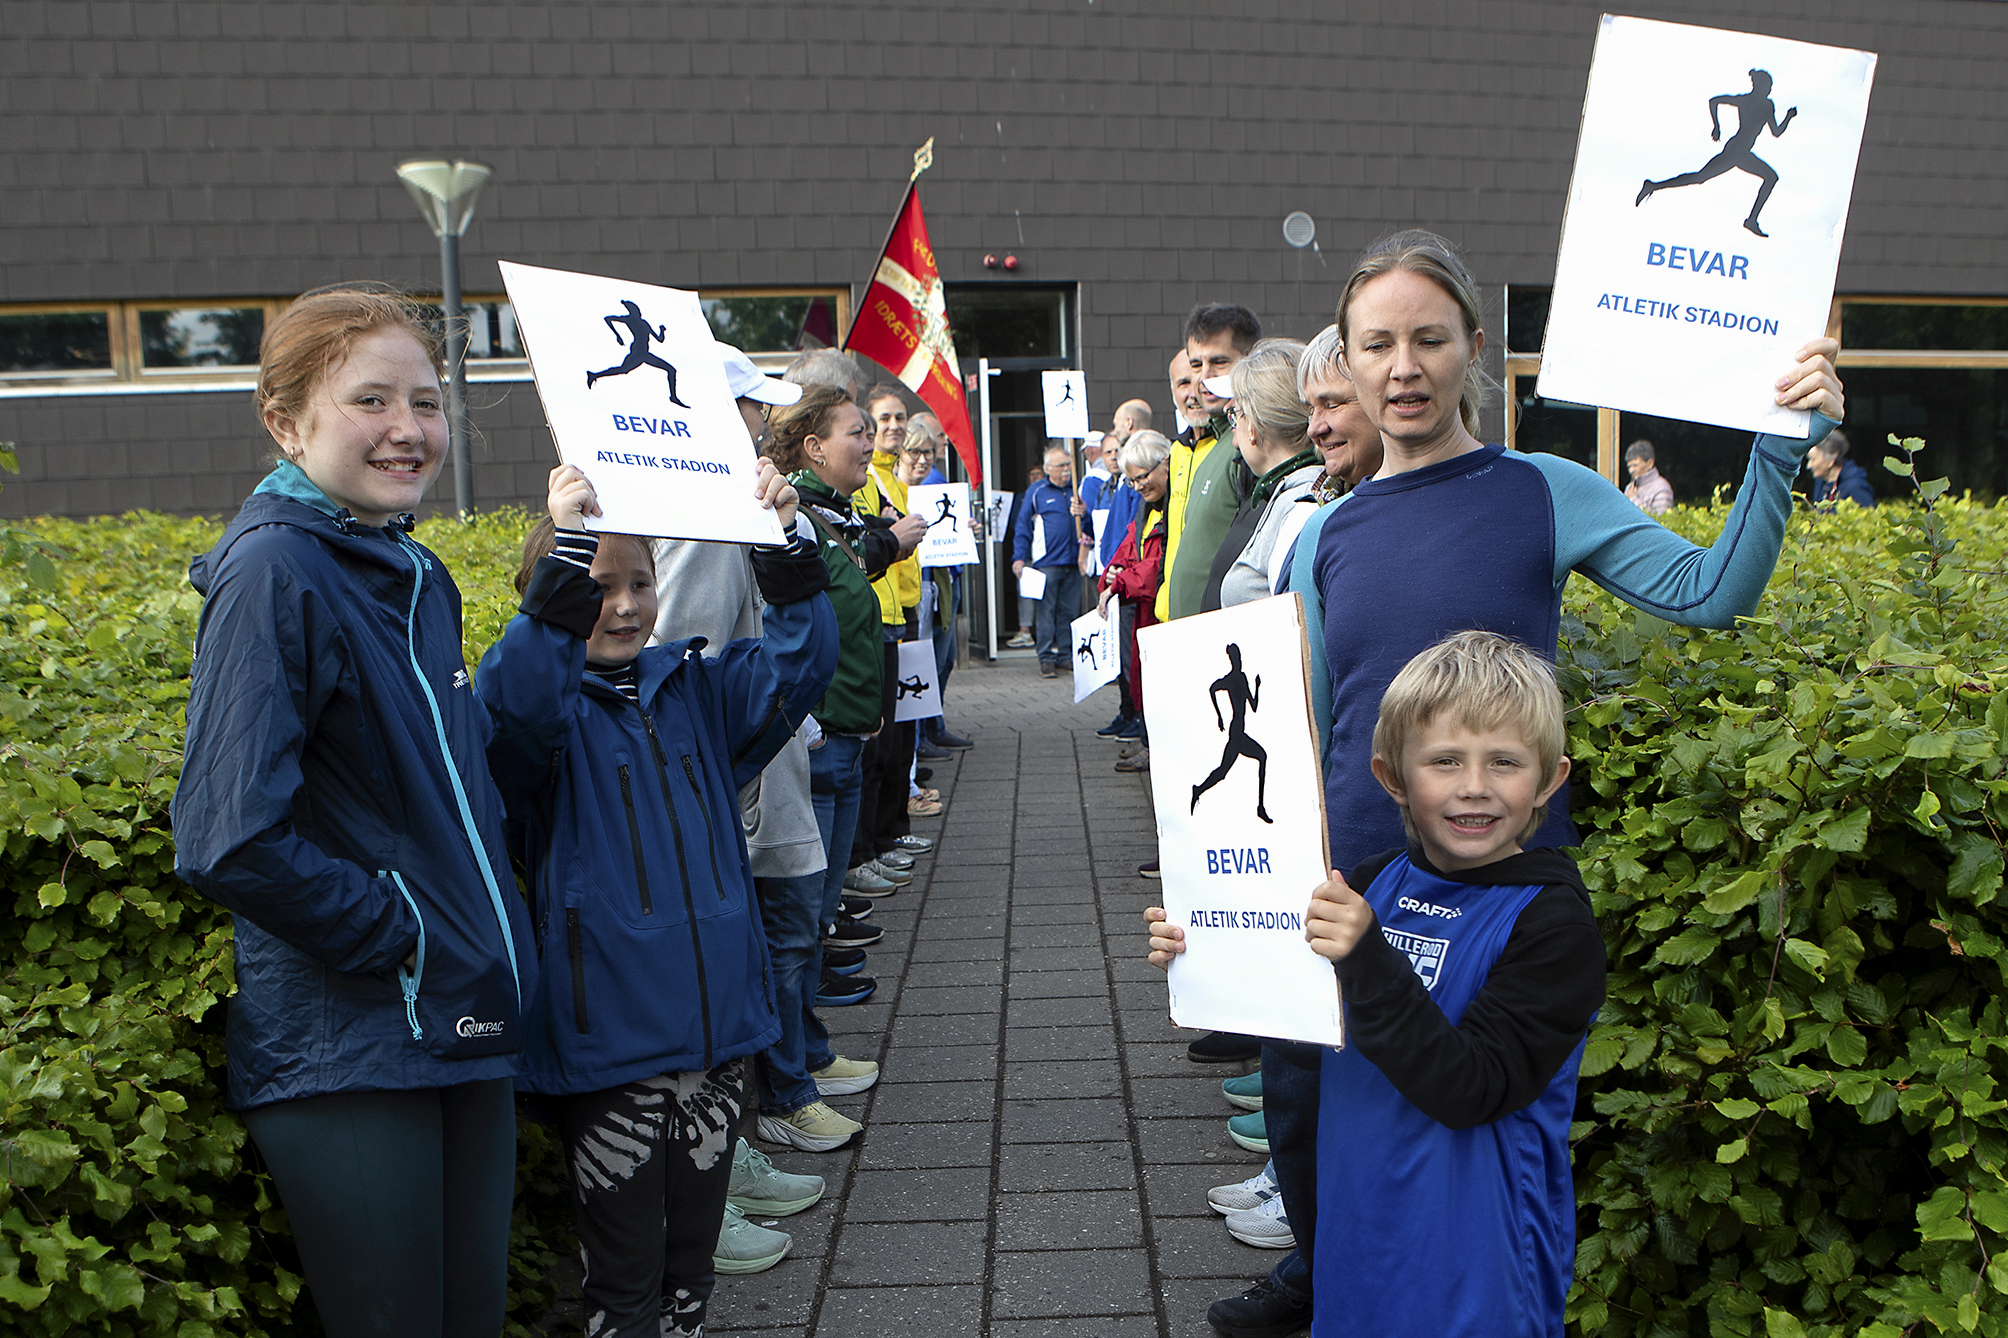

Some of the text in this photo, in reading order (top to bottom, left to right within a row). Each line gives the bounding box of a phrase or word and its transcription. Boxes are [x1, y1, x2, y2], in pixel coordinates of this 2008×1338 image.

[1646, 242, 1750, 280] BEVAR
[874, 299, 918, 349] IDRÆTS
[1597, 293, 1779, 336] ATLETIK STADION
[612, 413, 692, 438] BEVAR
[597, 450, 731, 475] ATLETIK STADION
[932, 537, 958, 546] BEVAR
[1206, 847, 1272, 875] BEVAR
[1397, 896, 1452, 918] CRAFT
[1190, 910, 1301, 931] ATLETIK STADION
